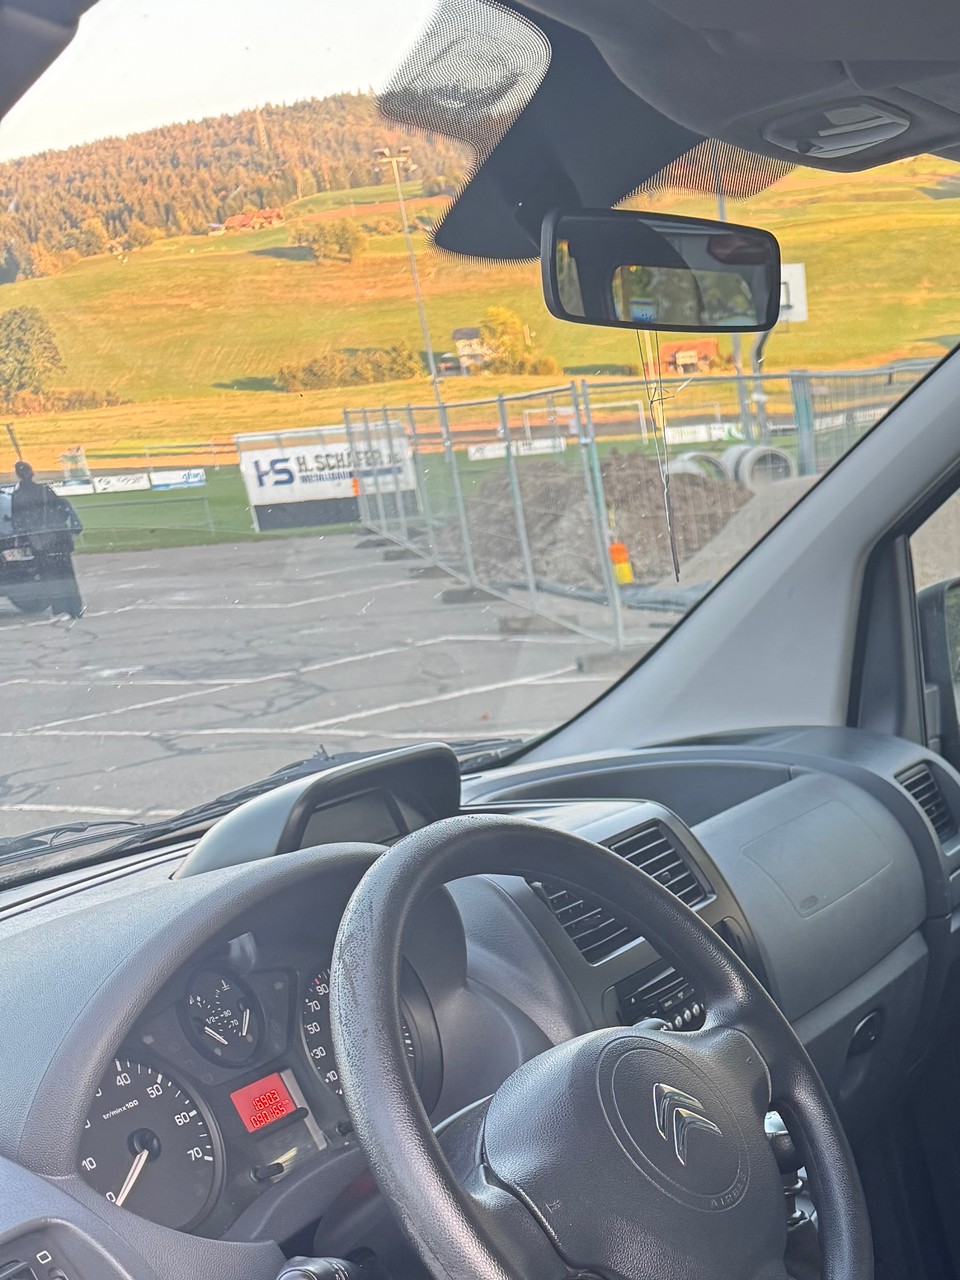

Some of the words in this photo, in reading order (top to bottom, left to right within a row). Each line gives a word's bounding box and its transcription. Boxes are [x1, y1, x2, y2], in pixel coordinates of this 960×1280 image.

[316, 983, 329, 995] 90
[307, 1000, 320, 1012] 70
[307, 1022, 320, 1034] 50
[312, 1046, 326, 1059] 30
[116, 1073, 131, 1086] 40
[327, 1070, 338, 1081] 10
[146, 1084, 163, 1098] 50
[252, 1089, 280, 1111] 16903
[174, 1111, 190, 1126] 60
[187, 1147, 203, 1161] 70
[81, 1157, 97, 1171] 10
